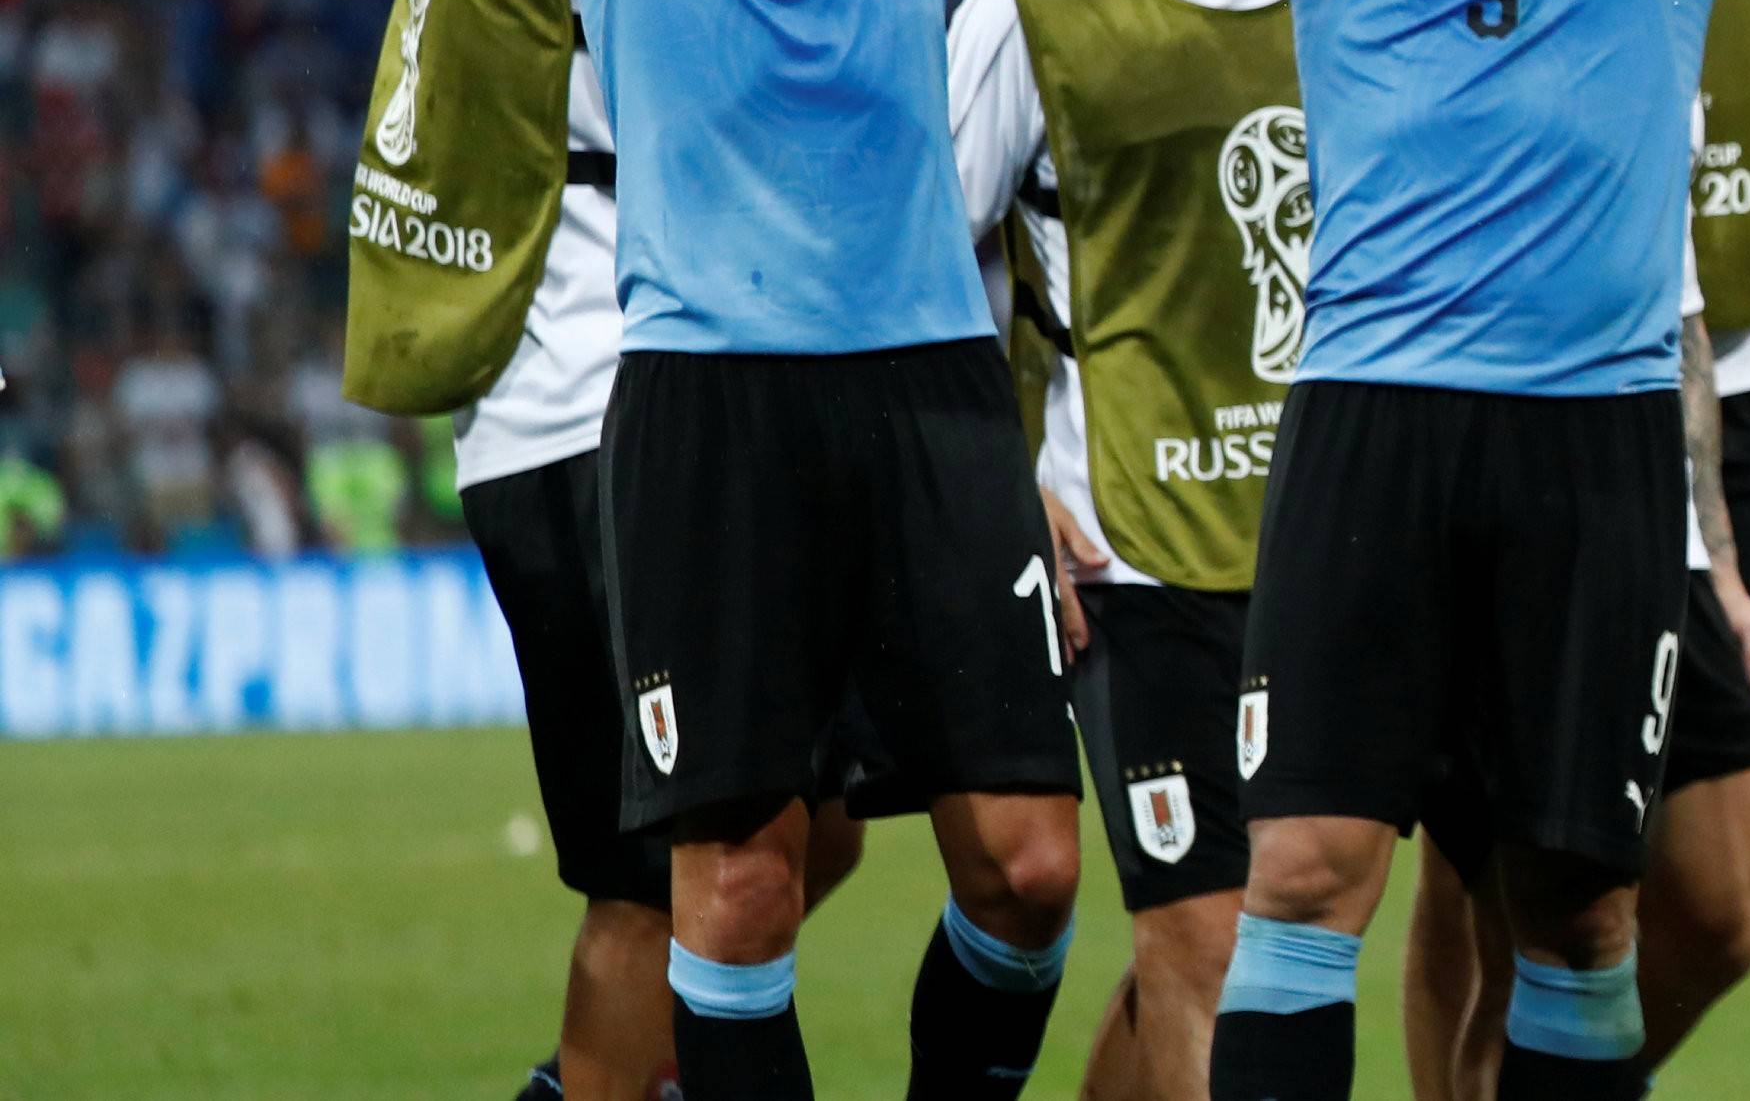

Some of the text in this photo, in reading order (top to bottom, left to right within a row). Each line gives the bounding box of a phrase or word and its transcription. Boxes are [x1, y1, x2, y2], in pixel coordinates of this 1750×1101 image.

[410, 189, 437, 215] CUP
[350, 194, 493, 272] SIA 2018
[1214, 403, 1258, 431] FIFA
[1154, 431, 1277, 482] RUSS
[1641, 630, 1679, 755] 9
